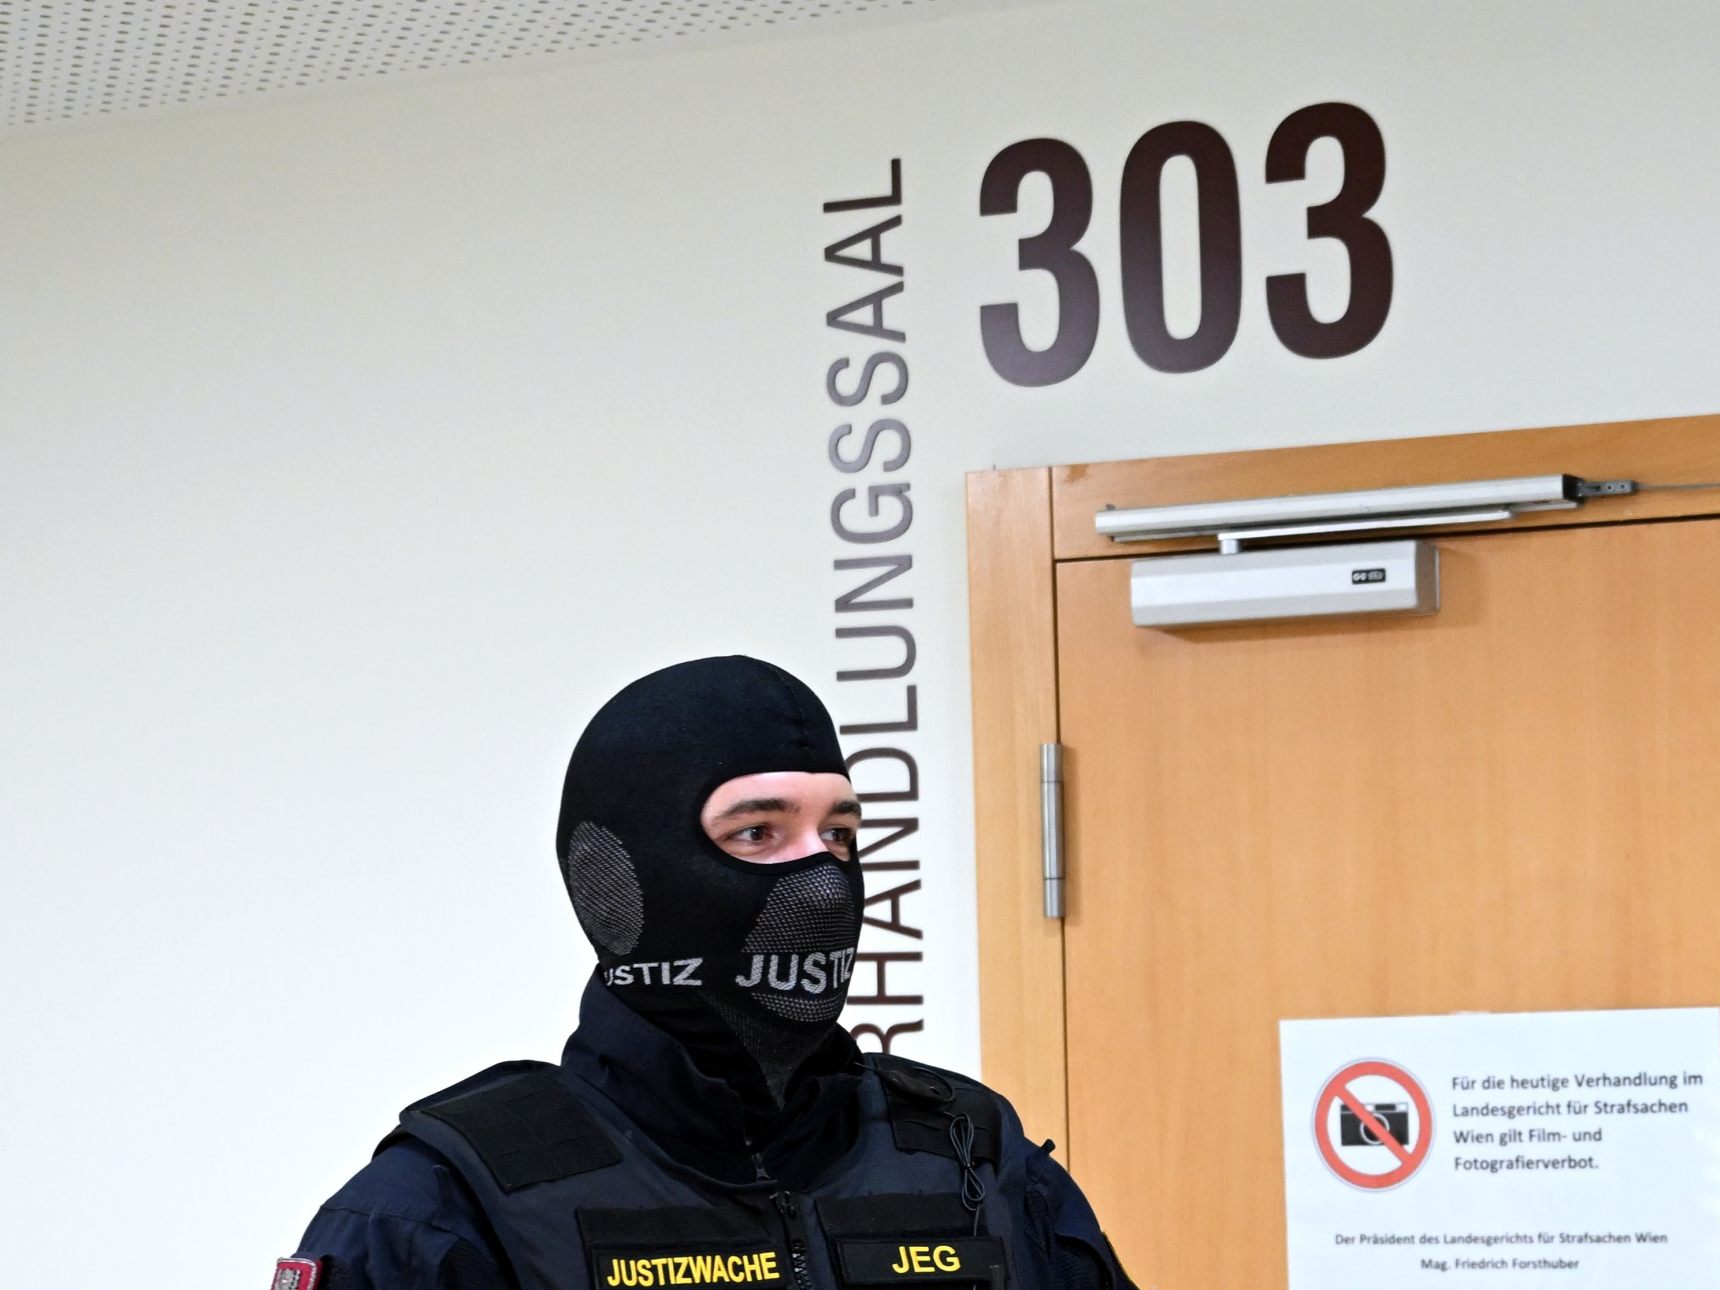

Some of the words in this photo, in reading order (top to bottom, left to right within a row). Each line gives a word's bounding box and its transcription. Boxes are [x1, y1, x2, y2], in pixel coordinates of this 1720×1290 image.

[979, 101, 1394, 387] 303
[735, 947, 854, 994] JUSTIZ
[1452, 1076, 1477, 1091] Für
[1482, 1075, 1505, 1090] die
[1510, 1074, 1569, 1092] heutige
[1574, 1072, 1678, 1090] Verhandlung
[1683, 1071, 1704, 1086] im
[1453, 1101, 1561, 1119] Landesgericht
[1566, 1100, 1590, 1116] für
[1594, 1099, 1689, 1115] Strafsachen
[1453, 1130, 1494, 1144] Wien
[1499, 1128, 1523, 1147] gilt
[1529, 1128, 1567, 1143] Film-
[1573, 1127, 1603, 1143] und
[1454, 1155, 1599, 1174] Fotografierverbot.
[1335, 1233, 1356, 1245] Der
[1360, 1233, 1415, 1246] Präsident
[1419, 1233, 1440, 1245] des
[1443, 1232, 1534, 1247] Landesgerichts
[1538, 1231, 1555, 1245] für
[1559, 1231, 1632, 1245] Strafsachen
[1635, 1231, 1669, 1244] Wien
[607, 1251, 780, 1287] JUSTIZWACHE
[891, 1246, 961, 1274] JEG
[1421, 1258, 1450, 1272] Mag.
[1455, 1258, 1509, 1270] Friedrich
[1512, 1257, 1580, 1270] Forsthuber
